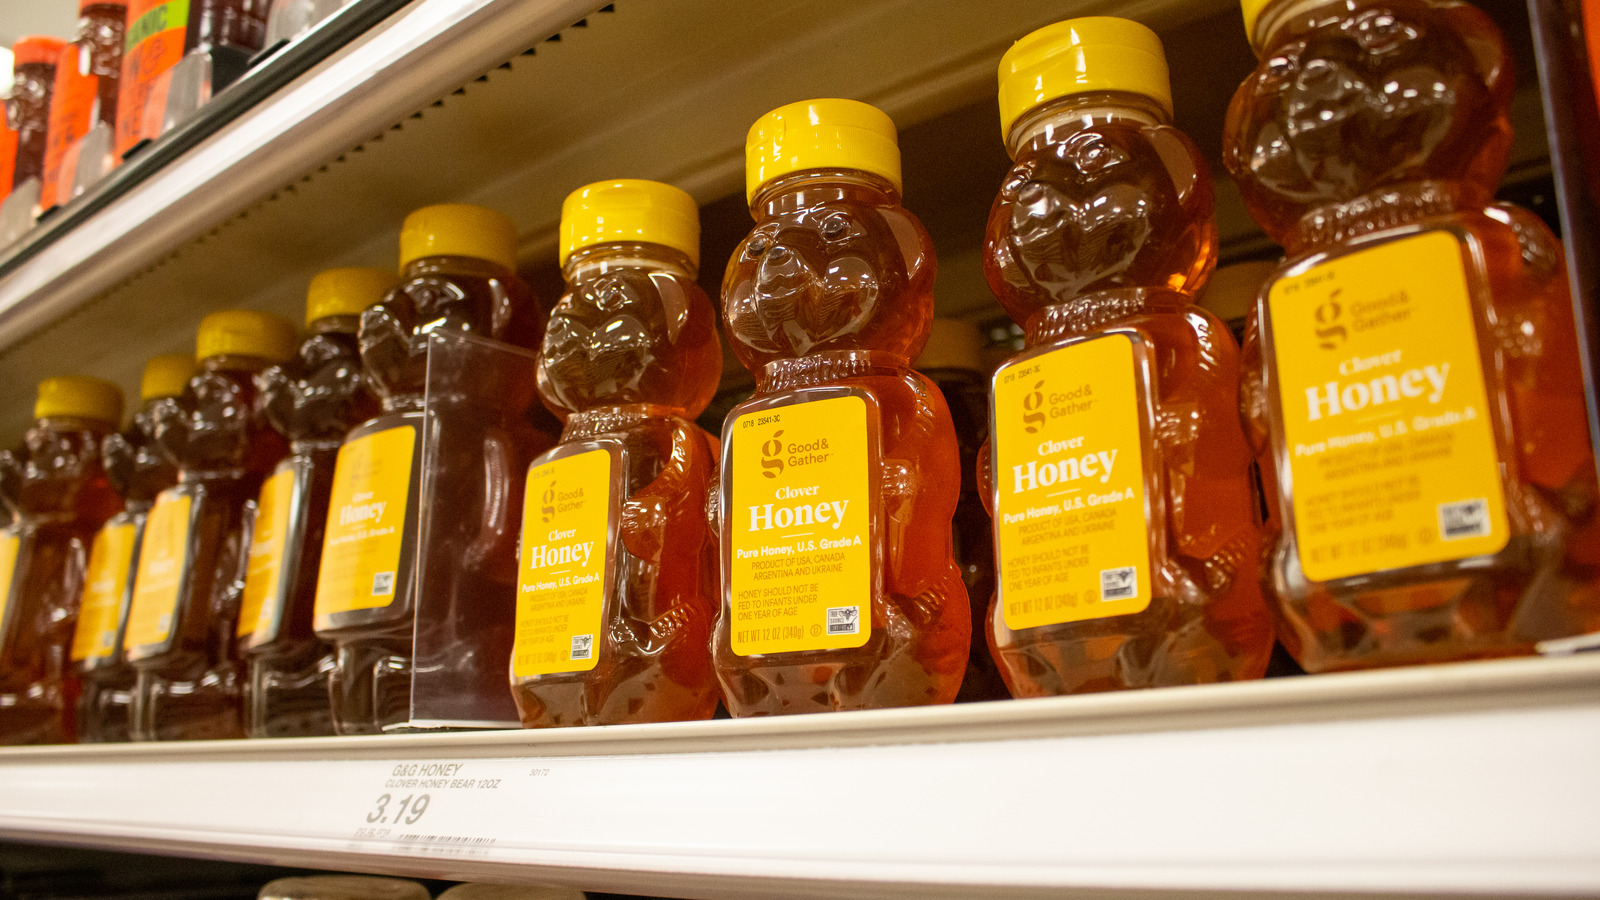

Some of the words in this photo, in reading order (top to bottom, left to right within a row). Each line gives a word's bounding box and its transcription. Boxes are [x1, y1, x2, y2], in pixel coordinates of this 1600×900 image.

[1305, 362, 1450, 421] Honey
[1050, 400, 1093, 419] Gather
[743, 420, 754, 428] 0718
[758, 414, 780, 426] 23541-3C
[1038, 436, 1084, 456] Clover
[788, 453, 829, 467] Gather
[1012, 449, 1118, 494] Honey
[775, 486, 820, 500] Clover
[340, 501, 387, 526] Honey
[558, 500, 583, 513] Gather
[1004, 512, 1025, 524] Pure
[1026, 504, 1062, 519] Honey,
[1063, 496, 1086, 511] U.S.
[1087, 490, 1124, 506] Grade
[1124, 487, 1134, 499] A
[748, 500, 849, 532] Honey
[548, 529, 576, 542] Clover
[530, 541, 594, 570] Honey
[737, 549, 758, 559] Pure
[761, 546, 794, 556] Honey,
[797, 540, 817, 552] U.S.
[820, 537, 852, 549] Grade
[853, 535, 861, 545] A
[752, 559, 784, 570] PRODUCT
[786, 558, 796, 567] OF
[796, 556, 812, 566] USA,
[814, 552, 846, 564] CANADA
[754, 569, 794, 580] ARGENTINA
[795, 567, 811, 576] AND
[812, 563, 843, 575] UKRAINE
[522, 584, 535, 593] Pure
[536, 581, 558, 590] Honey,
[559, 577, 571, 587] U.S.
[573, 573, 593, 584] Grade
[594, 572, 600, 582] A
[738, 589, 762, 600] HONEY
[763, 586, 792, 598] SHOULD
[793, 584, 808, 594] NOT
[810, 583, 819, 592] BE
[738, 602, 750, 610] FED
[752, 600, 762, 608] TO
[763, 597, 792, 608] INFANTS
[793, 594, 818, 605] UNDER
[738, 612, 752, 621] ONE
[754, 609, 771, 620] YEAR
[772, 608, 782, 617] OF
[783, 607, 798, 616] AGE
[738, 631, 750, 643] NET
[751, 630, 760, 642] WT
[763, 628, 770, 641] 12
[772, 627, 781, 640] OZ
[783, 625, 804, 640] (340g)
[392, 764, 417, 776] G&G
[418, 764, 464, 776] HONEY
[385, 779, 418, 788] CLOVER
[418, 780, 450, 788] HONEY
[450, 780, 475, 788] BEAR
[477, 780, 502, 789] 12OZ
[366, 793, 431, 825] 3.19
